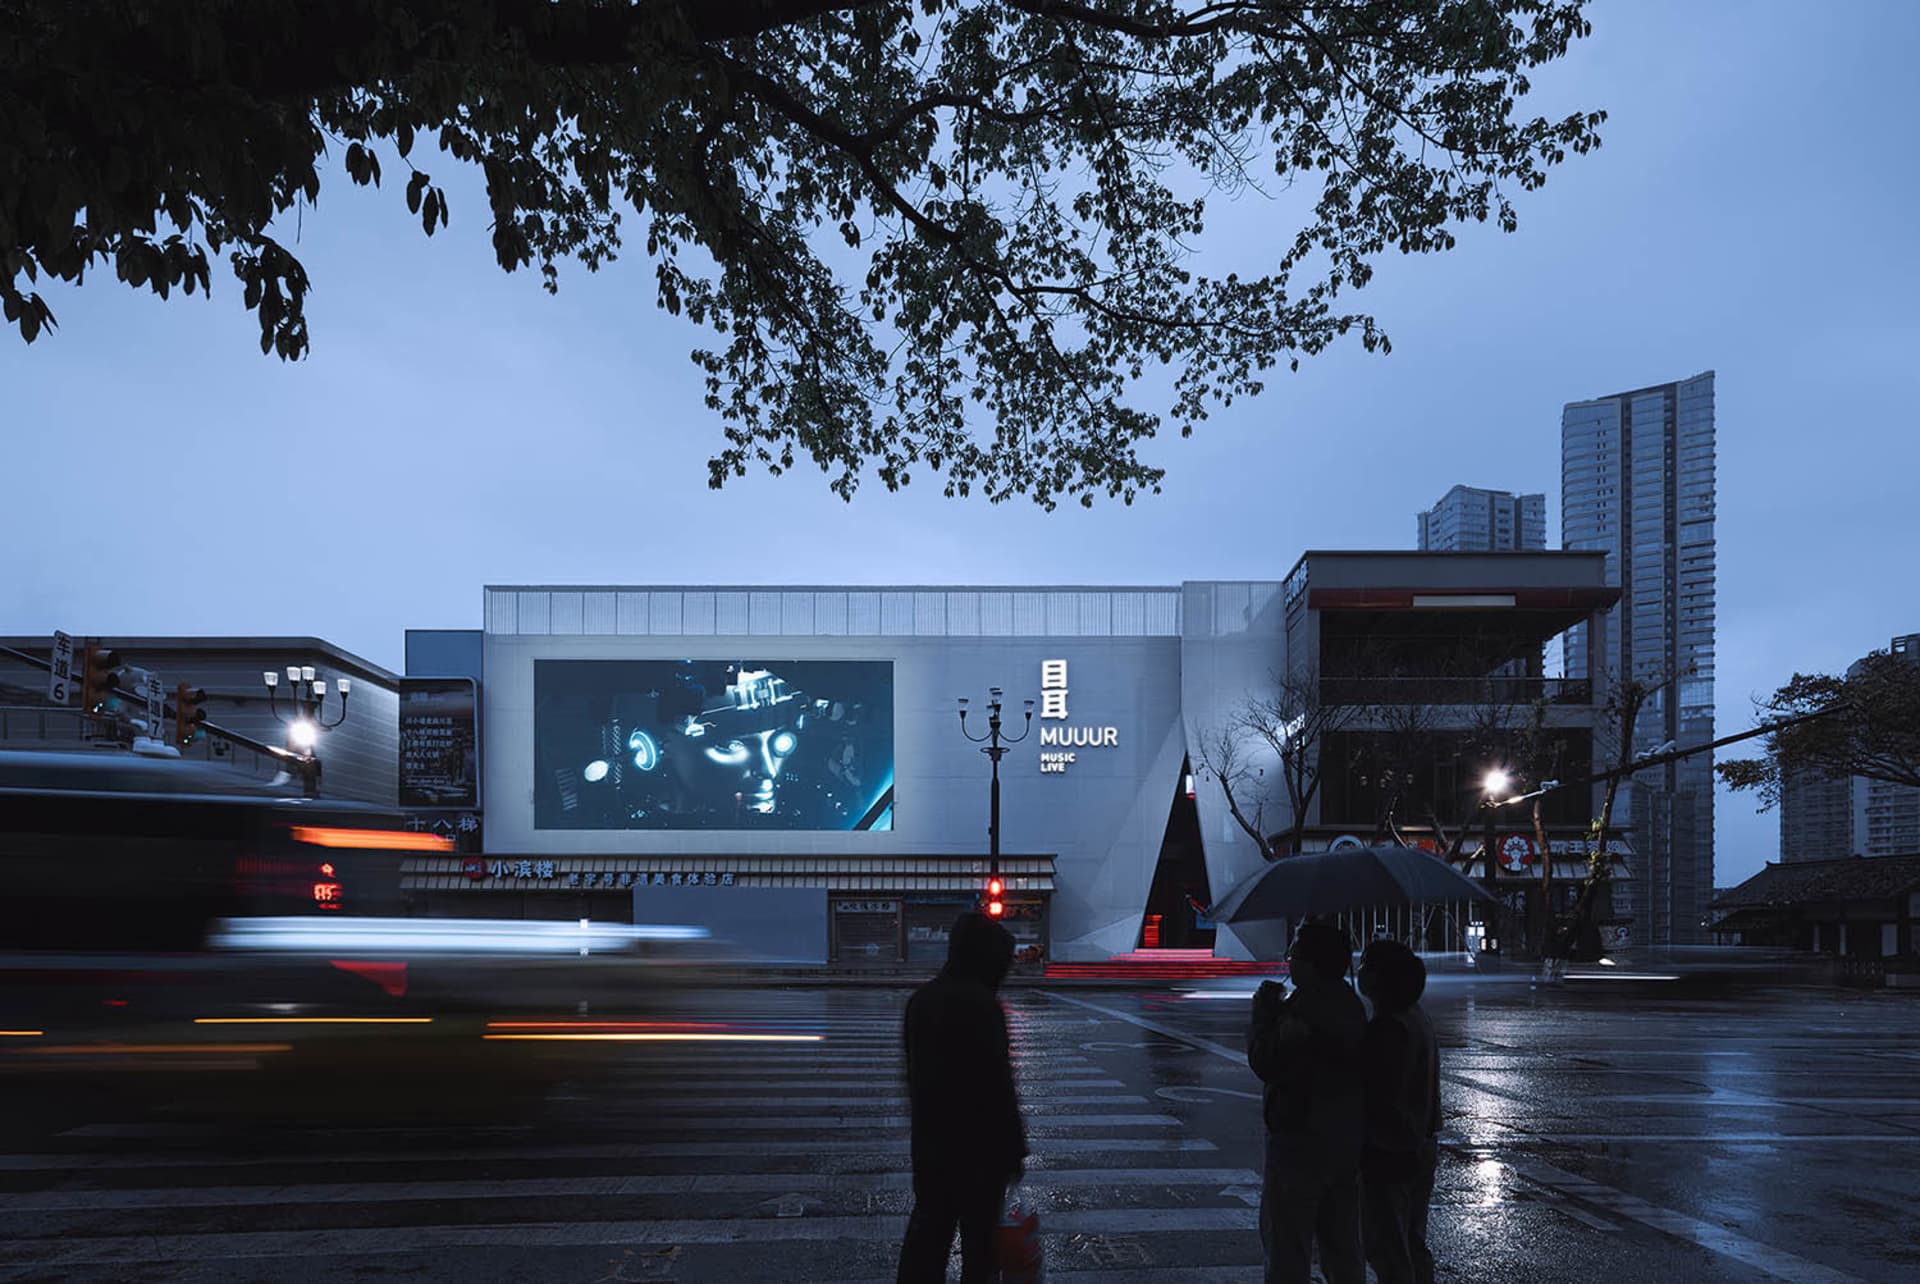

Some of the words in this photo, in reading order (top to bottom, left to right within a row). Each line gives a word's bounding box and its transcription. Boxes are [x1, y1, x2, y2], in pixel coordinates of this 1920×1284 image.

[1040, 727, 1118, 746] MUUUR
[1040, 752, 1076, 763] MUSIC
[1040, 763, 1066, 773] LIVE
